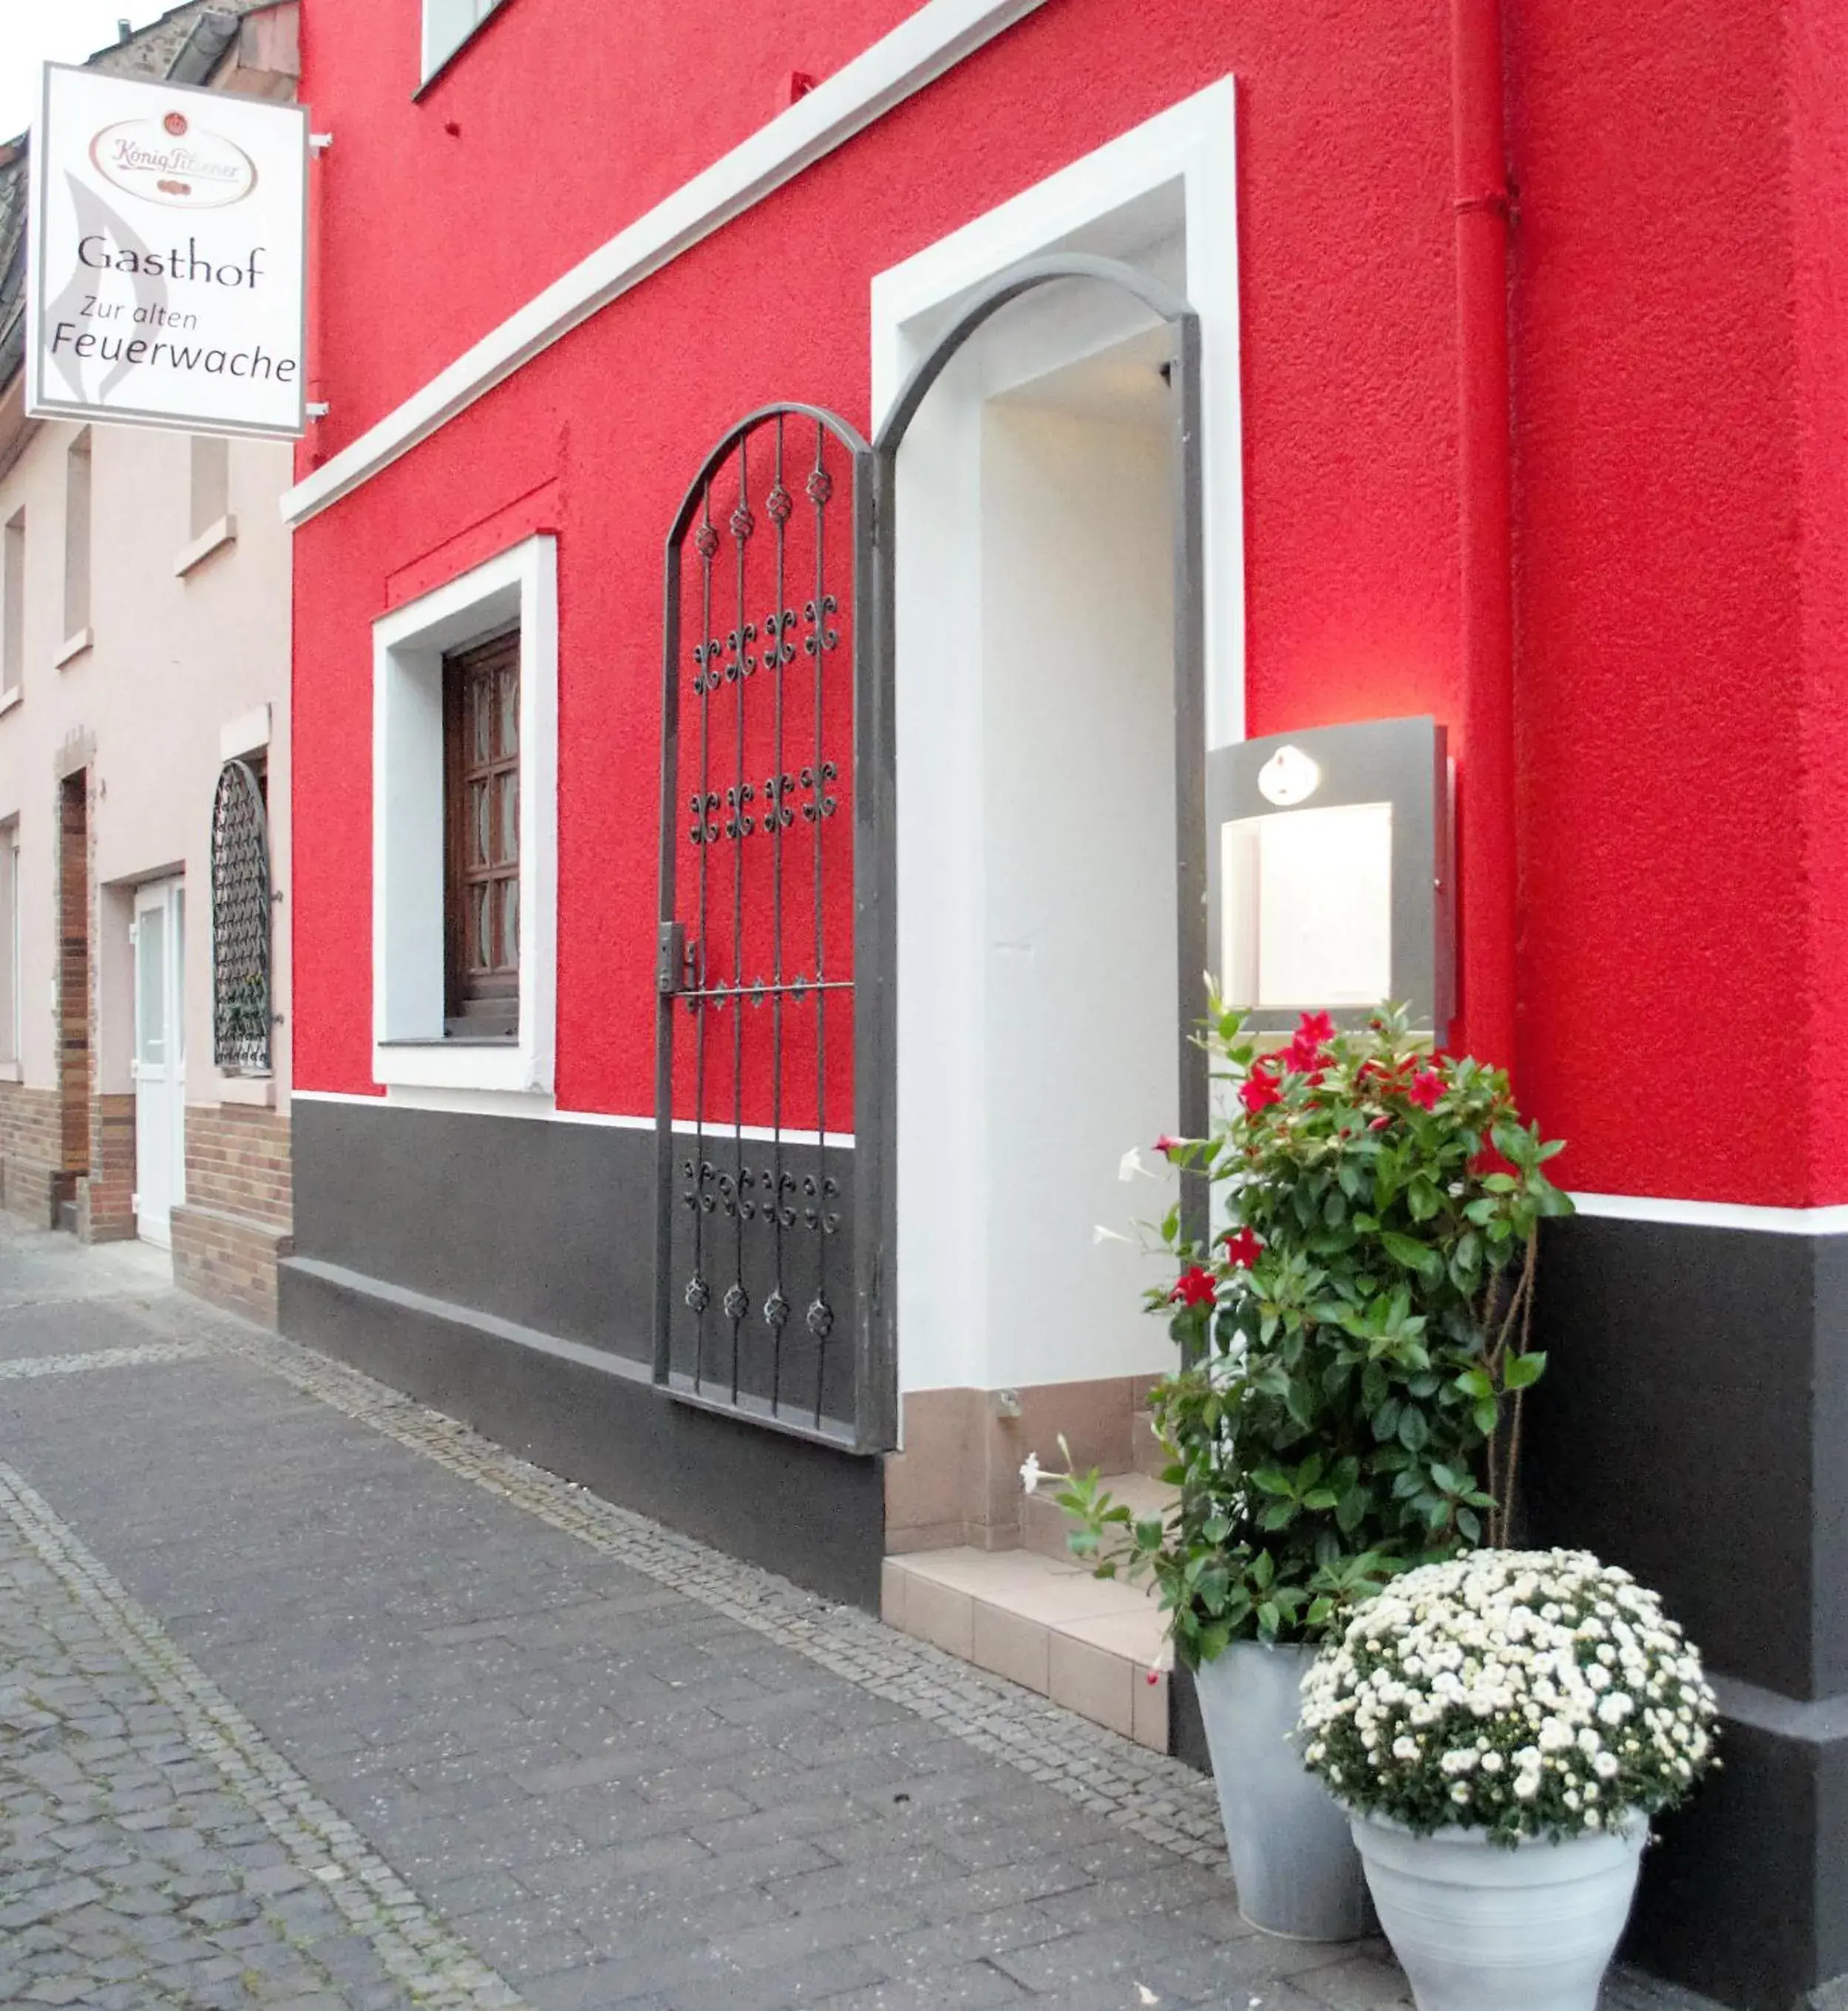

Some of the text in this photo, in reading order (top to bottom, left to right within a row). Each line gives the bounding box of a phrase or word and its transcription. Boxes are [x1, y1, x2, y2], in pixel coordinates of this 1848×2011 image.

[112, 139, 169, 171] König
[78, 235, 266, 288] Gasthof
[80, 296, 197, 330] Zur alten
[51, 322, 296, 382] Feuerwache
